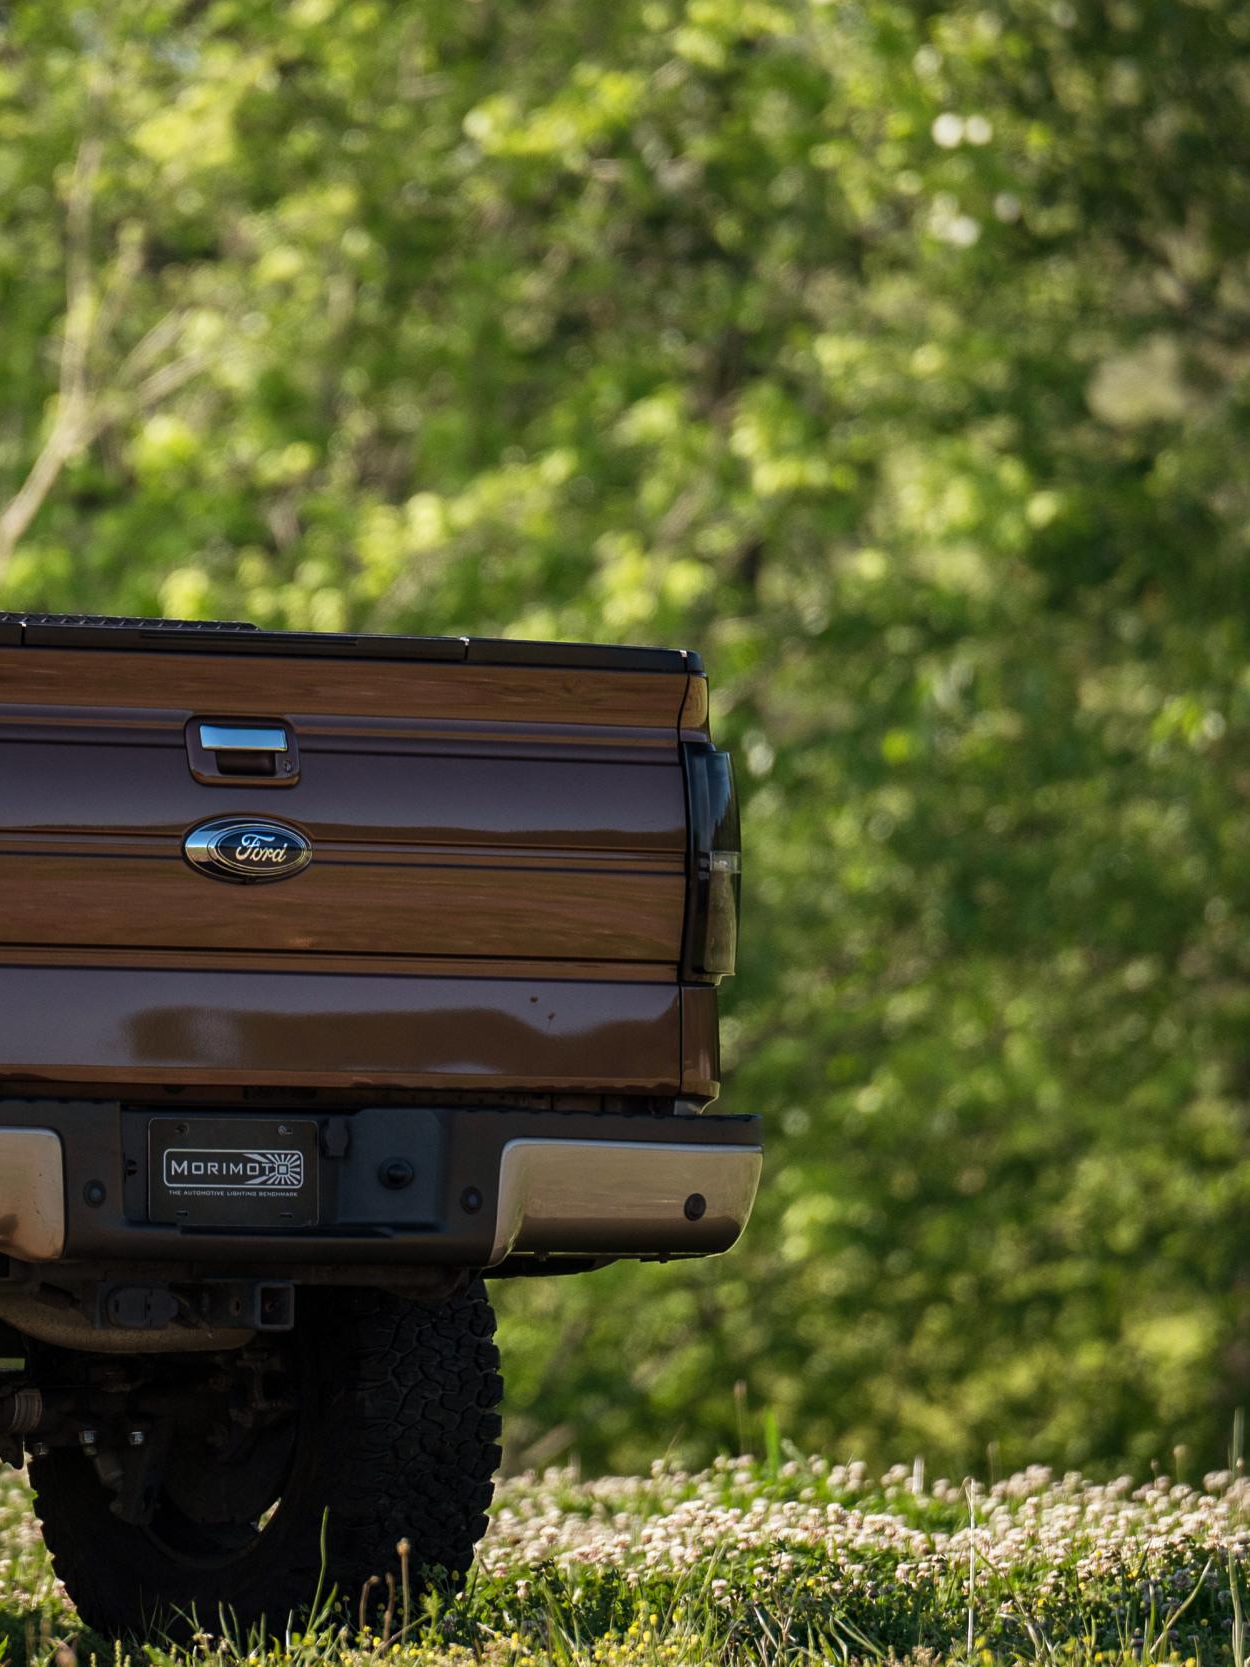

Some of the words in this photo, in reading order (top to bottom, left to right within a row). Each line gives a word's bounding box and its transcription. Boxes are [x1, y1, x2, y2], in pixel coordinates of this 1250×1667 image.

[234, 832, 289, 864] Ford
[169, 1189, 182, 1197] THE
[183, 1189, 225, 1198] AUTOMOTIVE
[226, 1190, 257, 1198] LIGHTING
[258, 1190, 299, 1198] BENCHMARK
